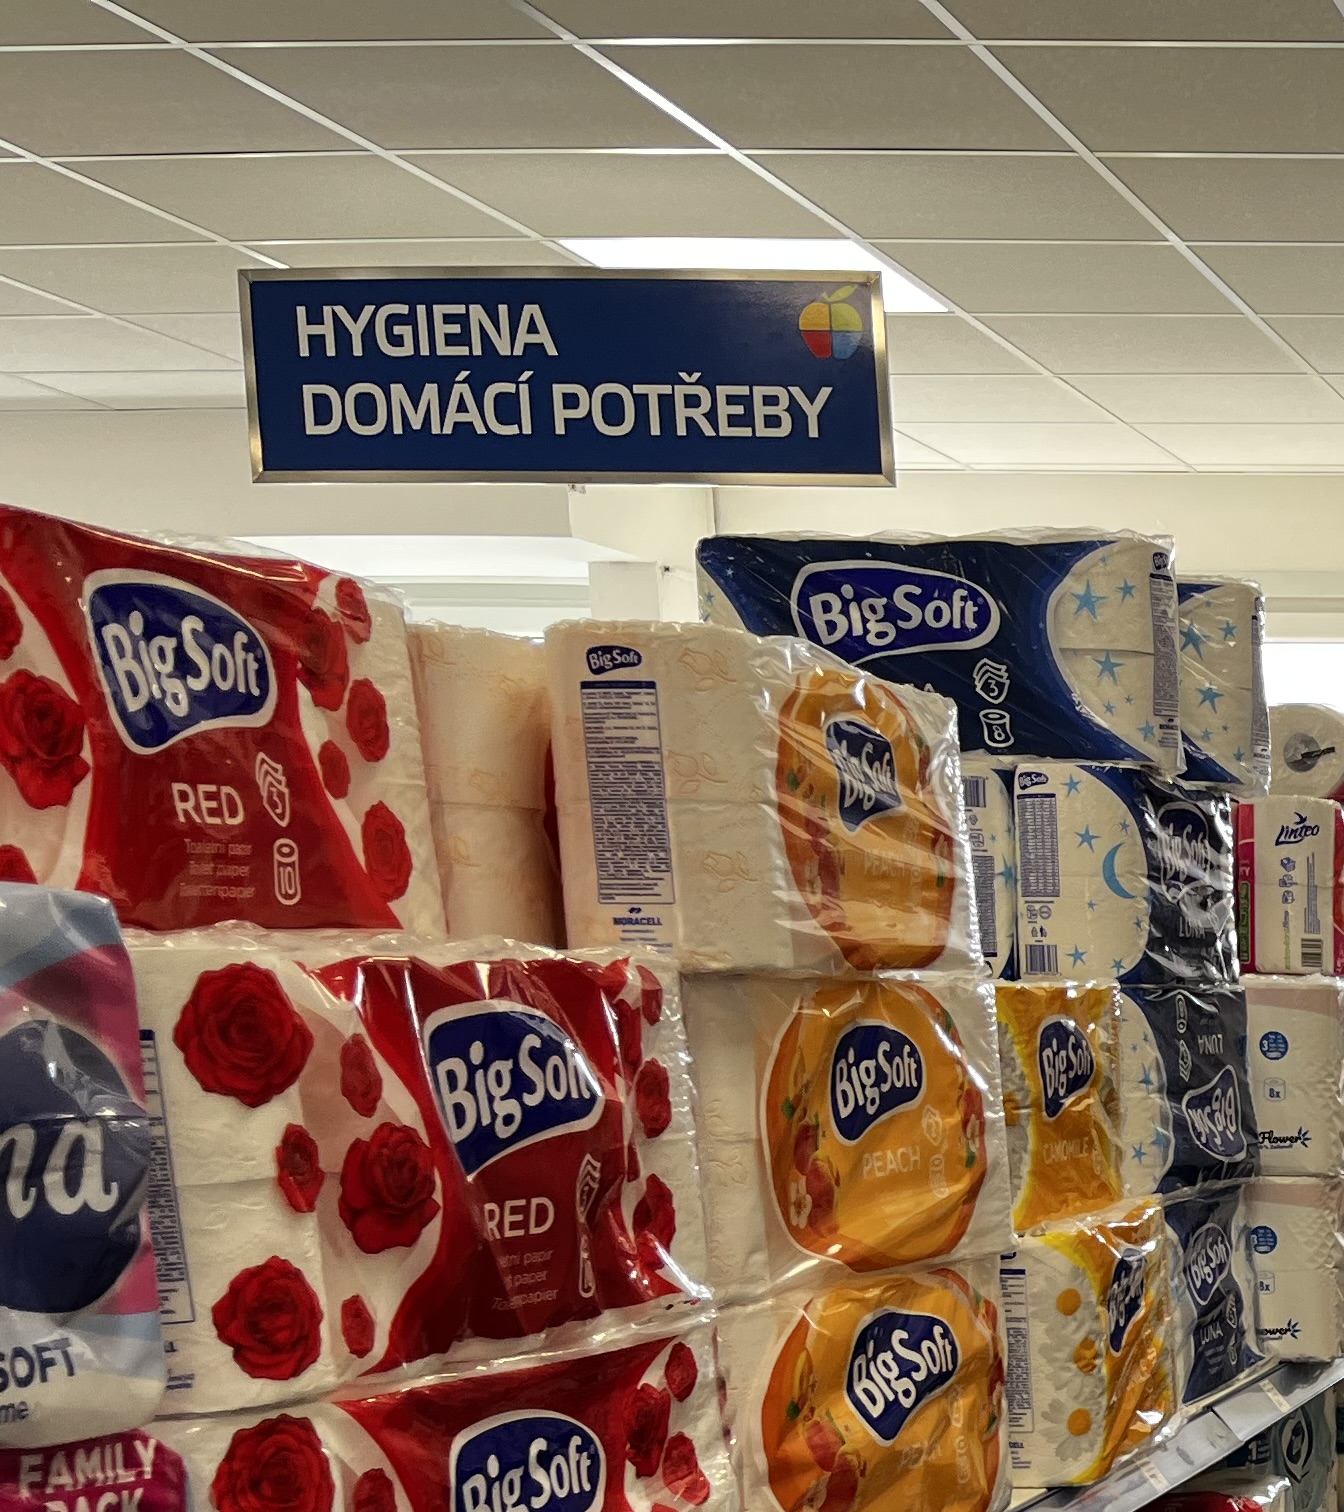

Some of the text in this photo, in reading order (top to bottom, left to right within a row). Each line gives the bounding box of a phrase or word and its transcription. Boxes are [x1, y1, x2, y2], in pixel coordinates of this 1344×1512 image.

[296, 303, 558, 357] HYGIENA
[302, 372, 833, 439] DOMÁCÍ POTŘEBY
[171, 782, 245, 826] RED
[1274, 824, 1320, 847] Linteo
[1258, 1131, 1303, 1145] Flower
[862, 1146, 921, 1179] PEACH
[483, 1196, 555, 1240] RED
[19, 1438, 158, 1498] FAMILY
